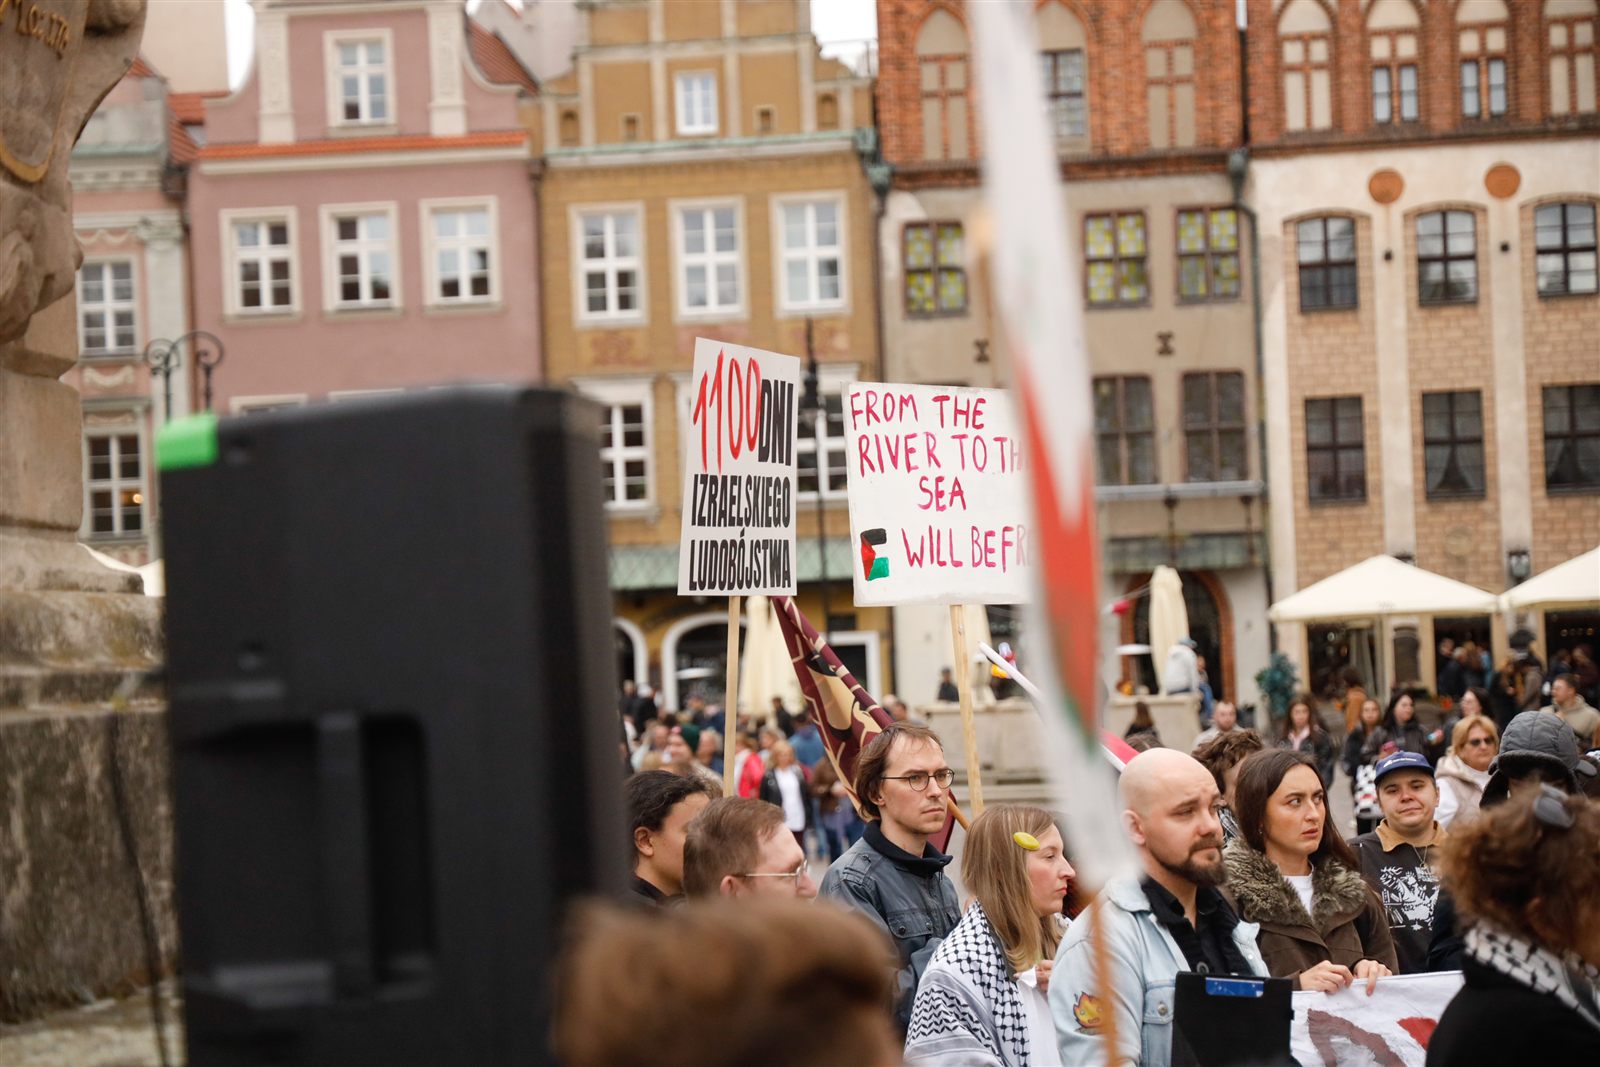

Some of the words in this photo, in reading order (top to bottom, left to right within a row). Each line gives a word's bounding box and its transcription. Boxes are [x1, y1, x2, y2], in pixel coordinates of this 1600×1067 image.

[693, 347, 762, 475] 1100
[758, 378, 794, 467] DNI
[850, 390, 919, 431] FROM
[932, 394, 986, 430] THE
[858, 431, 941, 478] RIVER
[950, 433, 987, 473] TO
[691, 473, 791, 528] IZRAELSKIEGO
[917, 475, 967, 512] SEA
[689, 527, 791, 591] LUDOBÓJSTWA
[901, 524, 963, 568] WILL
